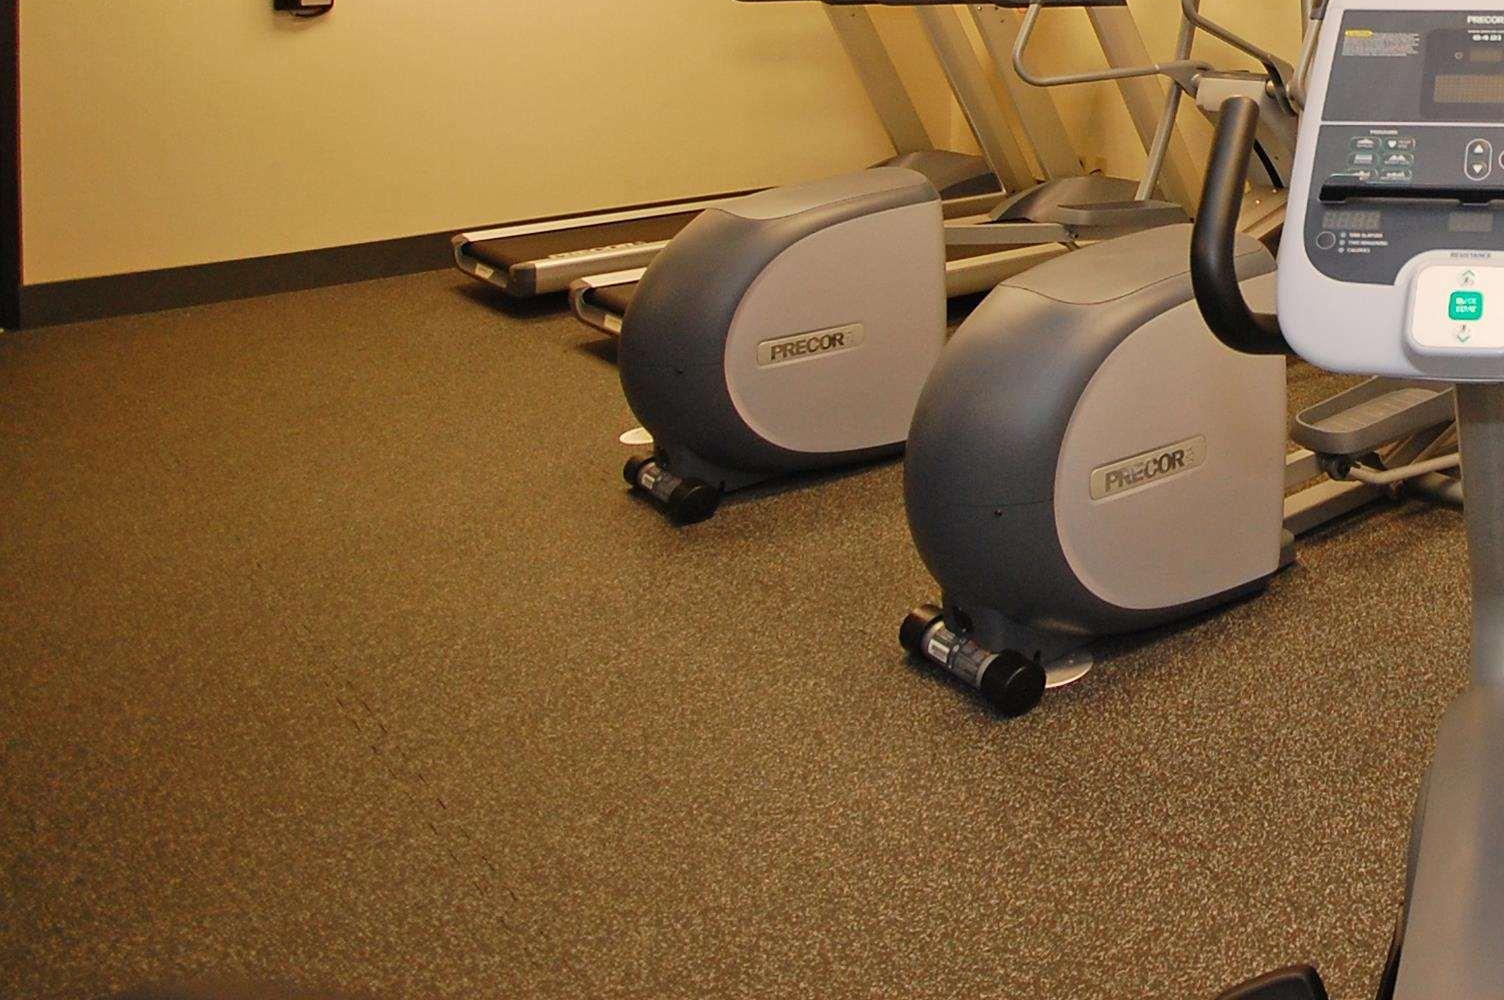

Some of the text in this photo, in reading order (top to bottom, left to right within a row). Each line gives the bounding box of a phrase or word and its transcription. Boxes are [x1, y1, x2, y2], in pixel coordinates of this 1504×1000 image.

[1467, 15, 1504, 24] PRECOR
[770, 332, 845, 360] PRECOR
[1105, 449, 1185, 493] PRECOR
